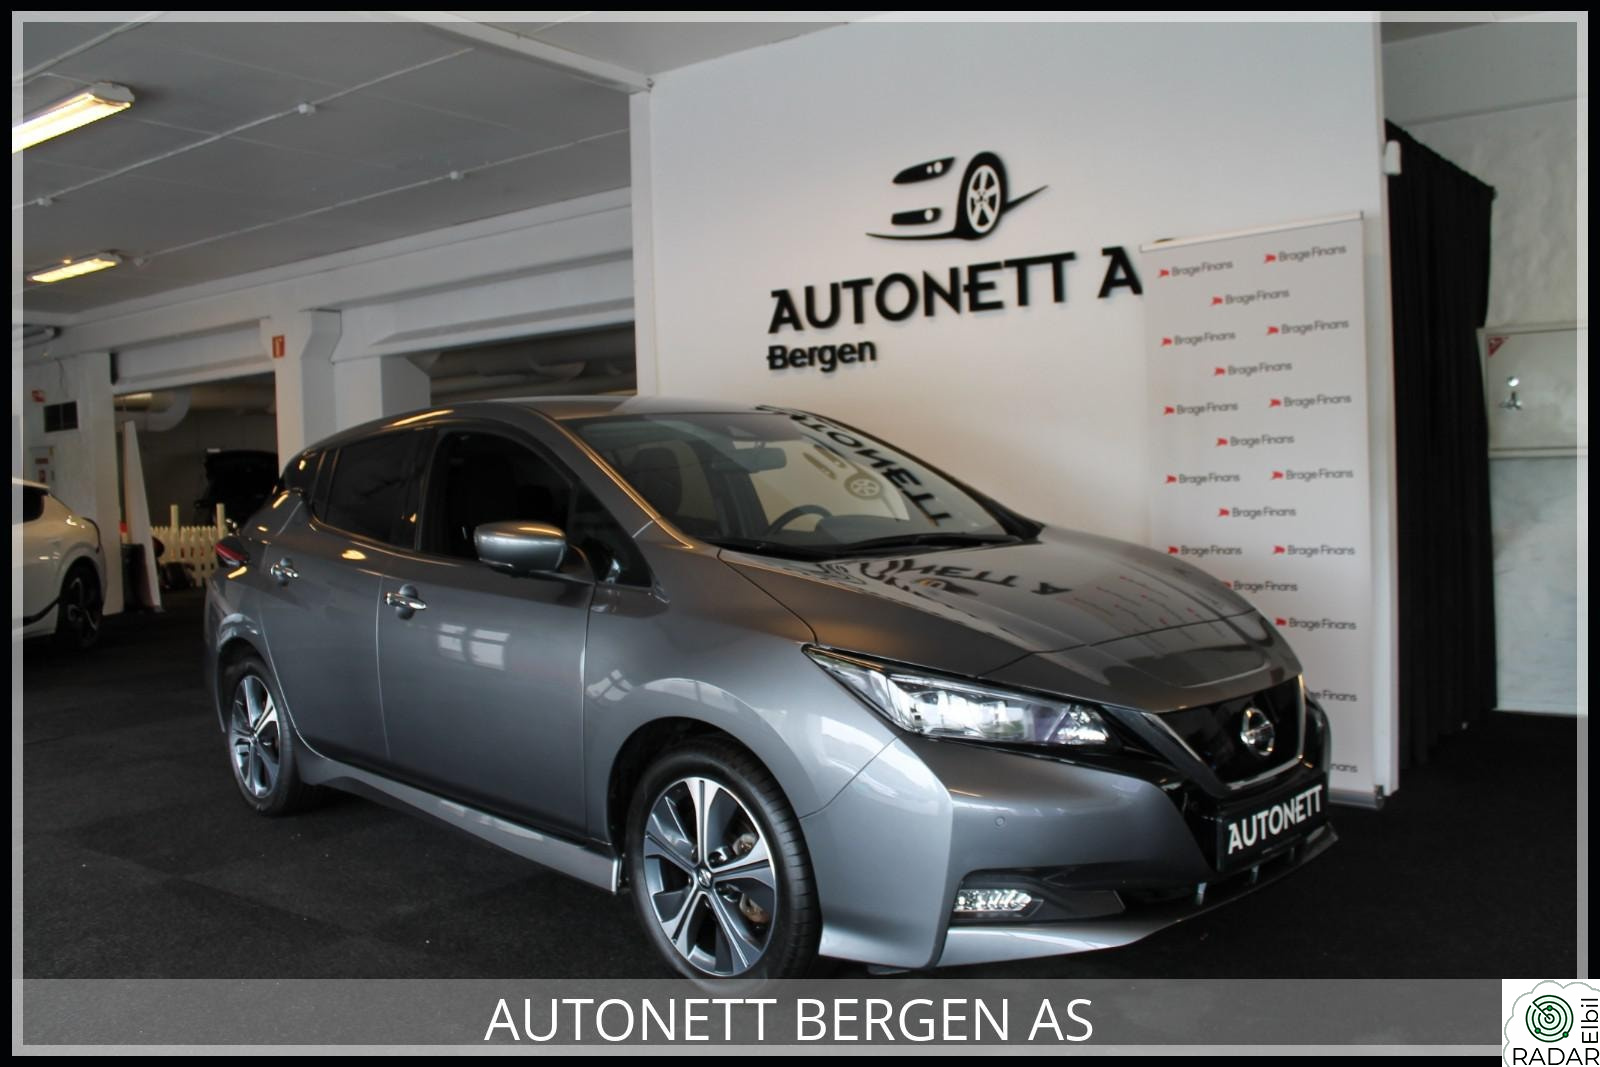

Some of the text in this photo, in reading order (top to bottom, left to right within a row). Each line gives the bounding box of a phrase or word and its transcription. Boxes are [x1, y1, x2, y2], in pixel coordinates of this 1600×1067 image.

[1277, 245, 1347, 263] Brage Finans
[1171, 261, 1234, 278] Brage Finans
[768, 245, 1143, 334] AUTONETT A
[1224, 289, 1290, 305] Brage Finans
[1280, 319, 1350, 336] Brage Finans
[1173, 331, 1237, 347] Brage Finans
[767, 341, 877, 372] Bergen
[1227, 362, 1293, 377] Brage Finans
[1175, 401, 1239, 417] Brage Finans
[1283, 393, 1353, 409] Brage Finans
[1229, 434, 1295, 449] Brage Finans
[1178, 472, 1241, 487] Brage Finans
[1285, 467, 1354, 483] Brage Finans
[1231, 505, 1297, 521] Brage Finans
[1179, 544, 1243, 558] Brage Finans
[1286, 544, 1356, 559] Brage Finans
[1232, 580, 1299, 594] Brage Finans
[1287, 617, 1357, 632] Brage Finans
[1330, 763, 1359, 774] nans
[1227, 785, 1323, 855] AUTONETT
